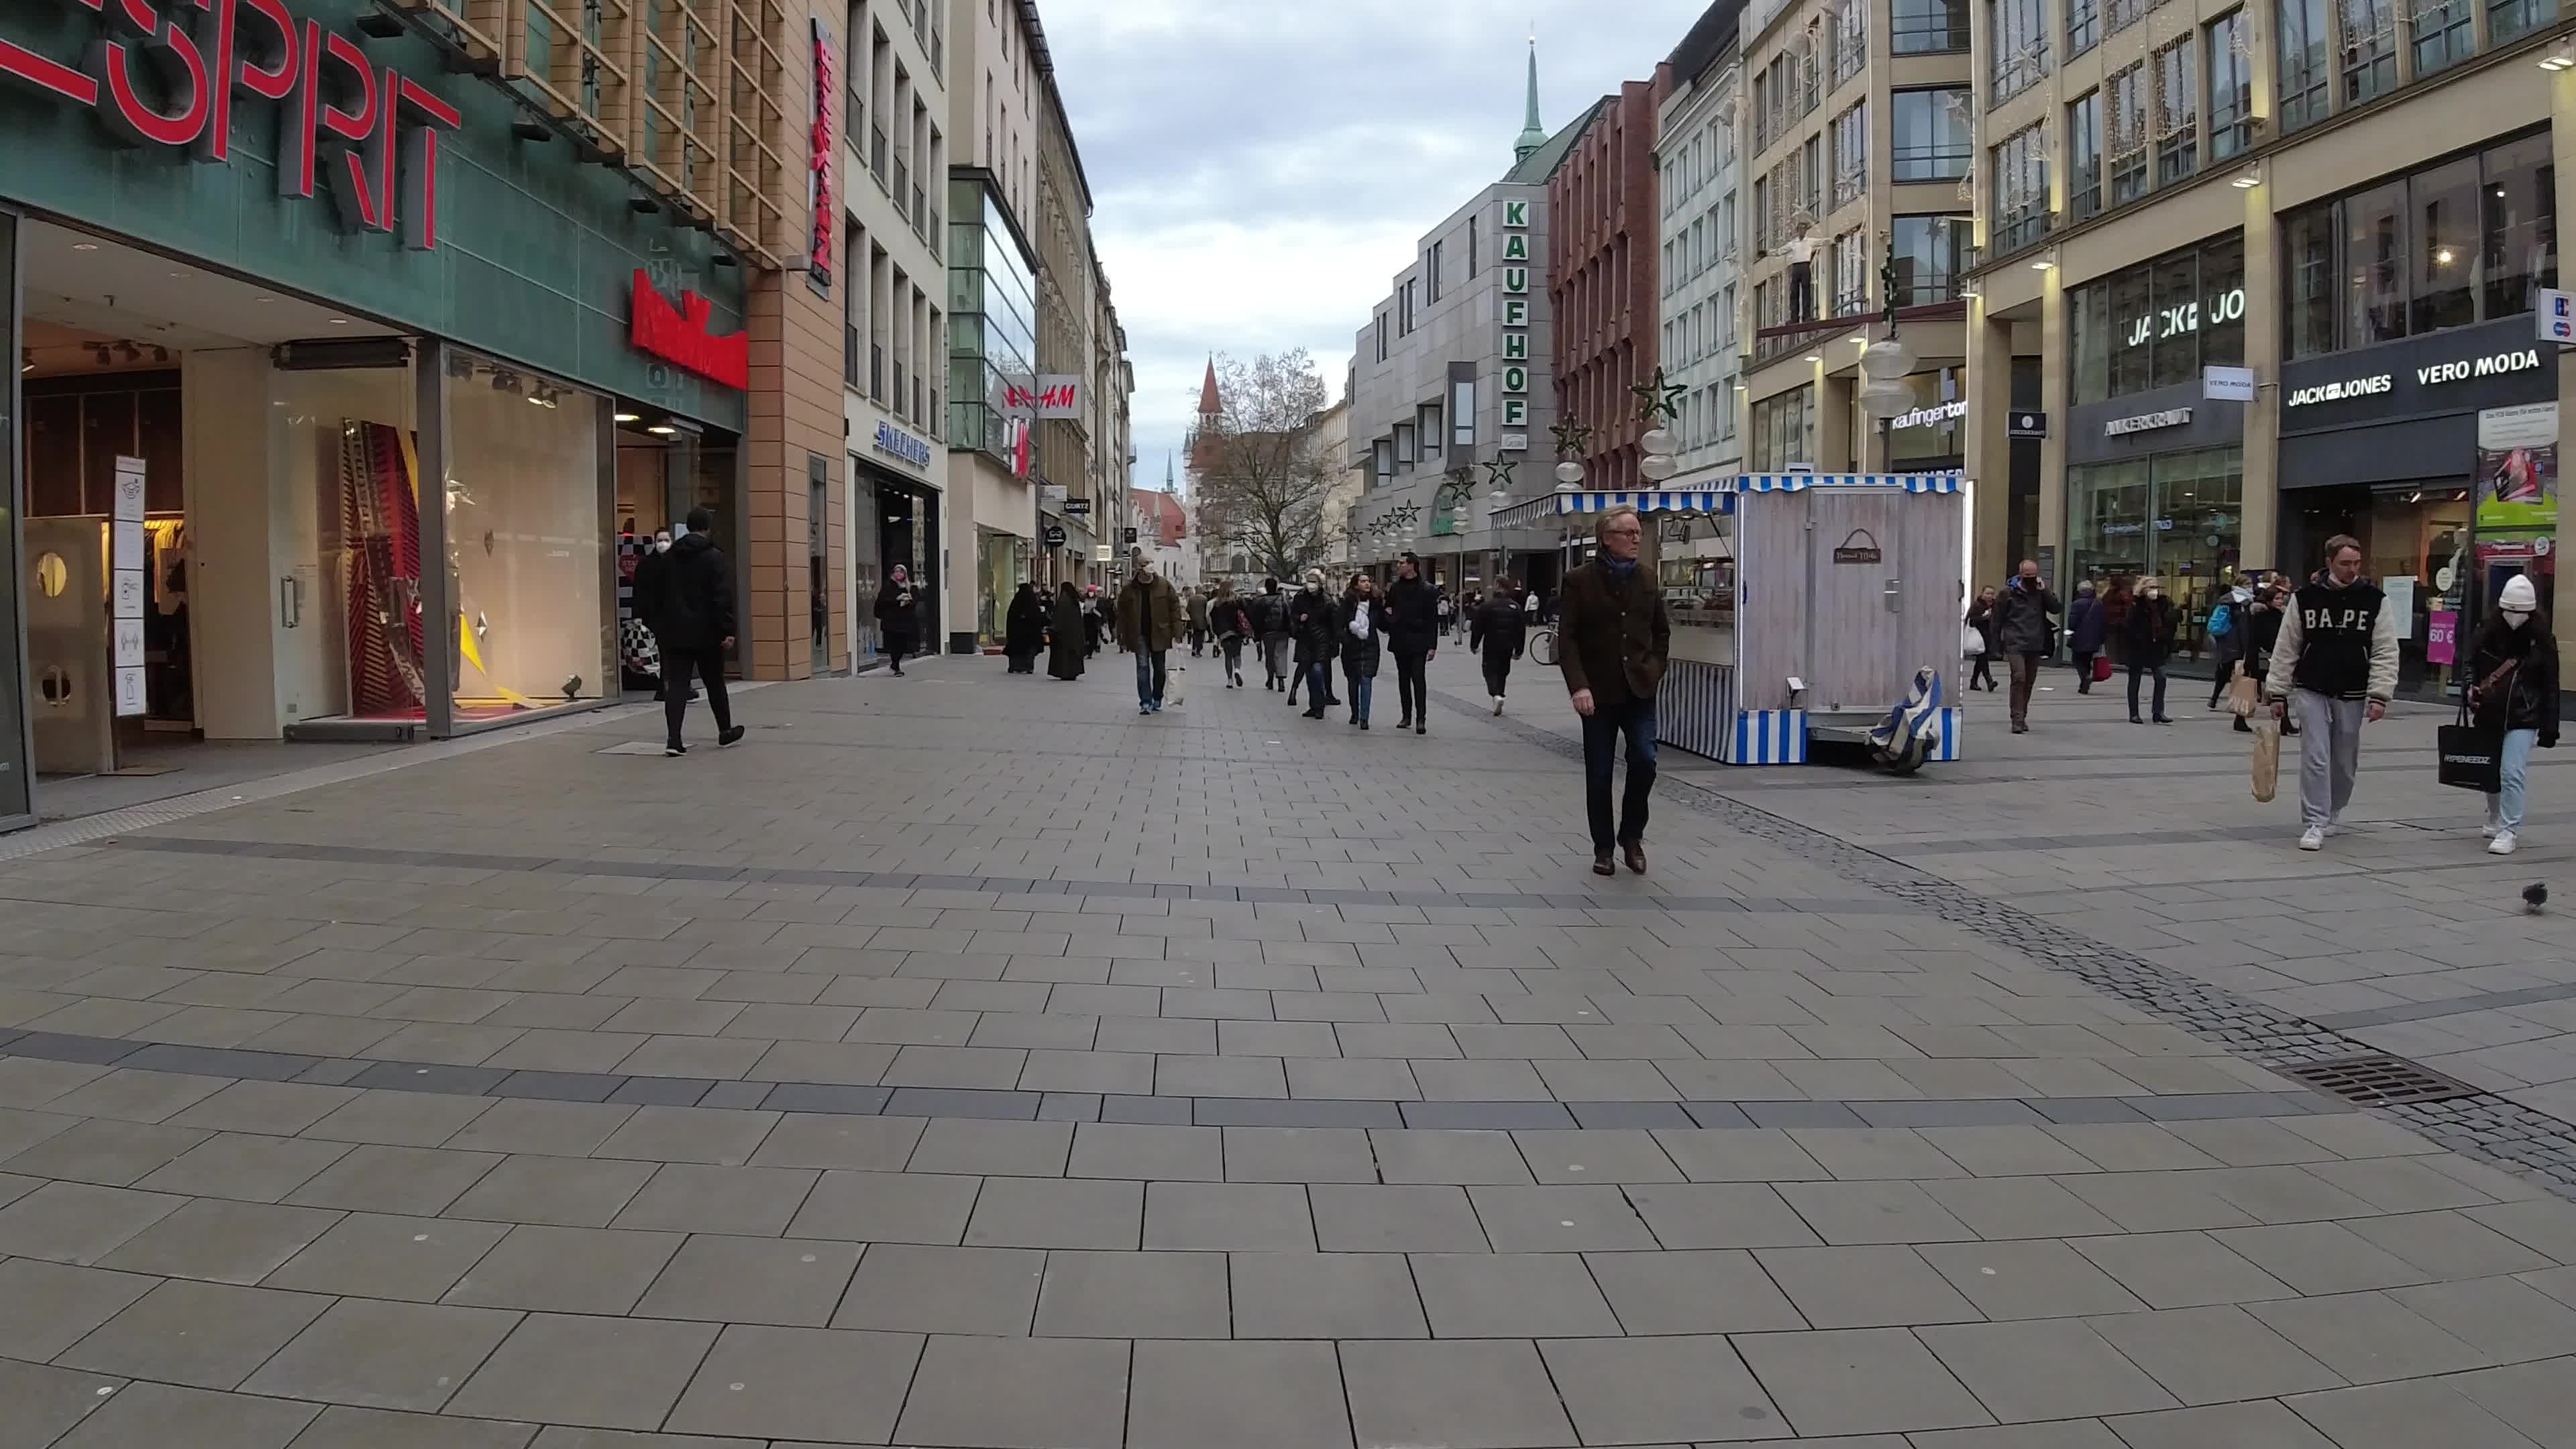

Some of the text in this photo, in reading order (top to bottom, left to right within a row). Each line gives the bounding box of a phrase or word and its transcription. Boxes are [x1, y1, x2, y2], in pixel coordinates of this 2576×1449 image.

[1506, 202, 1526, 423] KAUFHOF
[2417, 350, 2539, 385] VERO MODA
[1040, 384, 1075, 409] H&M
[874, 419, 930, 468] SKECHERS
[2430, 629, 2444, 643] 60
